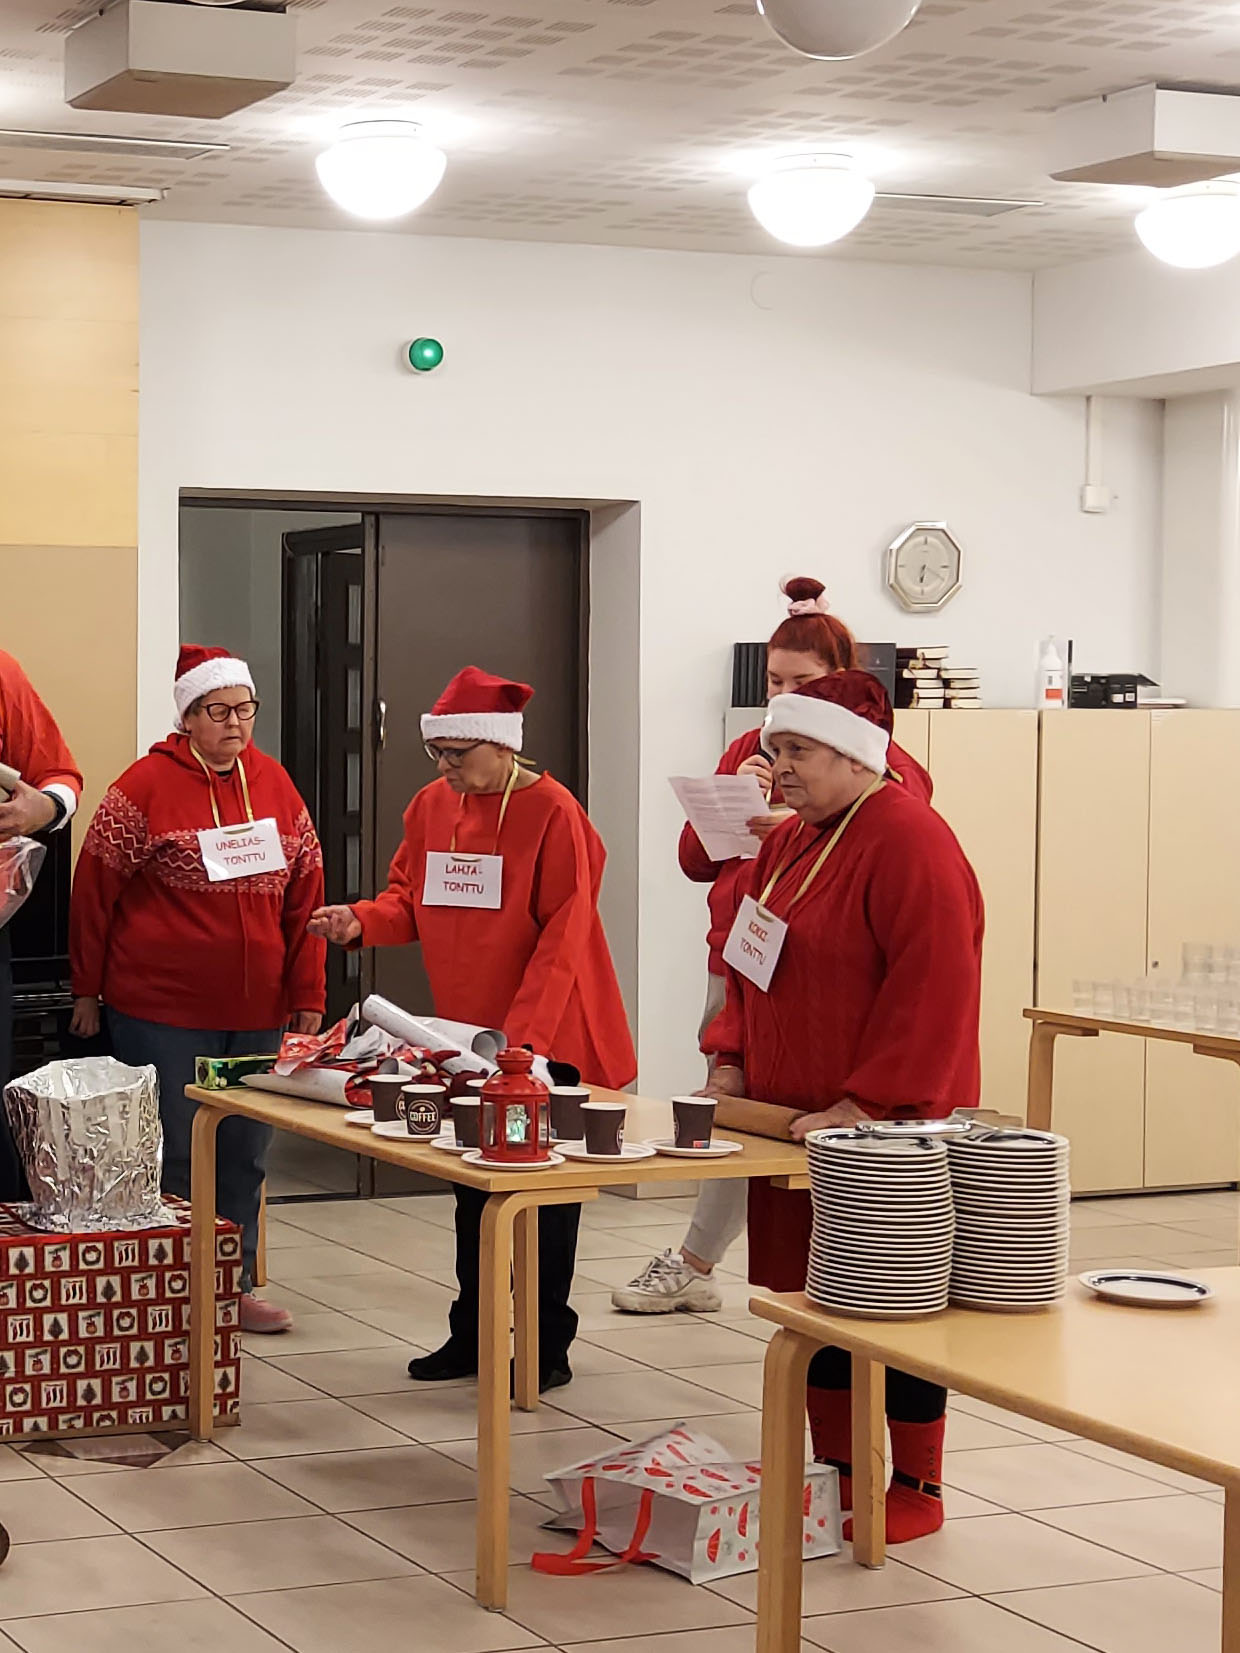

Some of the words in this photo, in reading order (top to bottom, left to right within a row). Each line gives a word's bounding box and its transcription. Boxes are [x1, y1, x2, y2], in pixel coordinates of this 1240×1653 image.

[215, 837, 266, 851] UNELIAS-
[223, 852, 266, 866] TONTTU
[445, 863, 483, 875] LAHJA-
[443, 881, 484, 894] TONTTU
[740, 937, 767, 966] TONTTU
[409, 1111, 437, 1122] COFFEE
